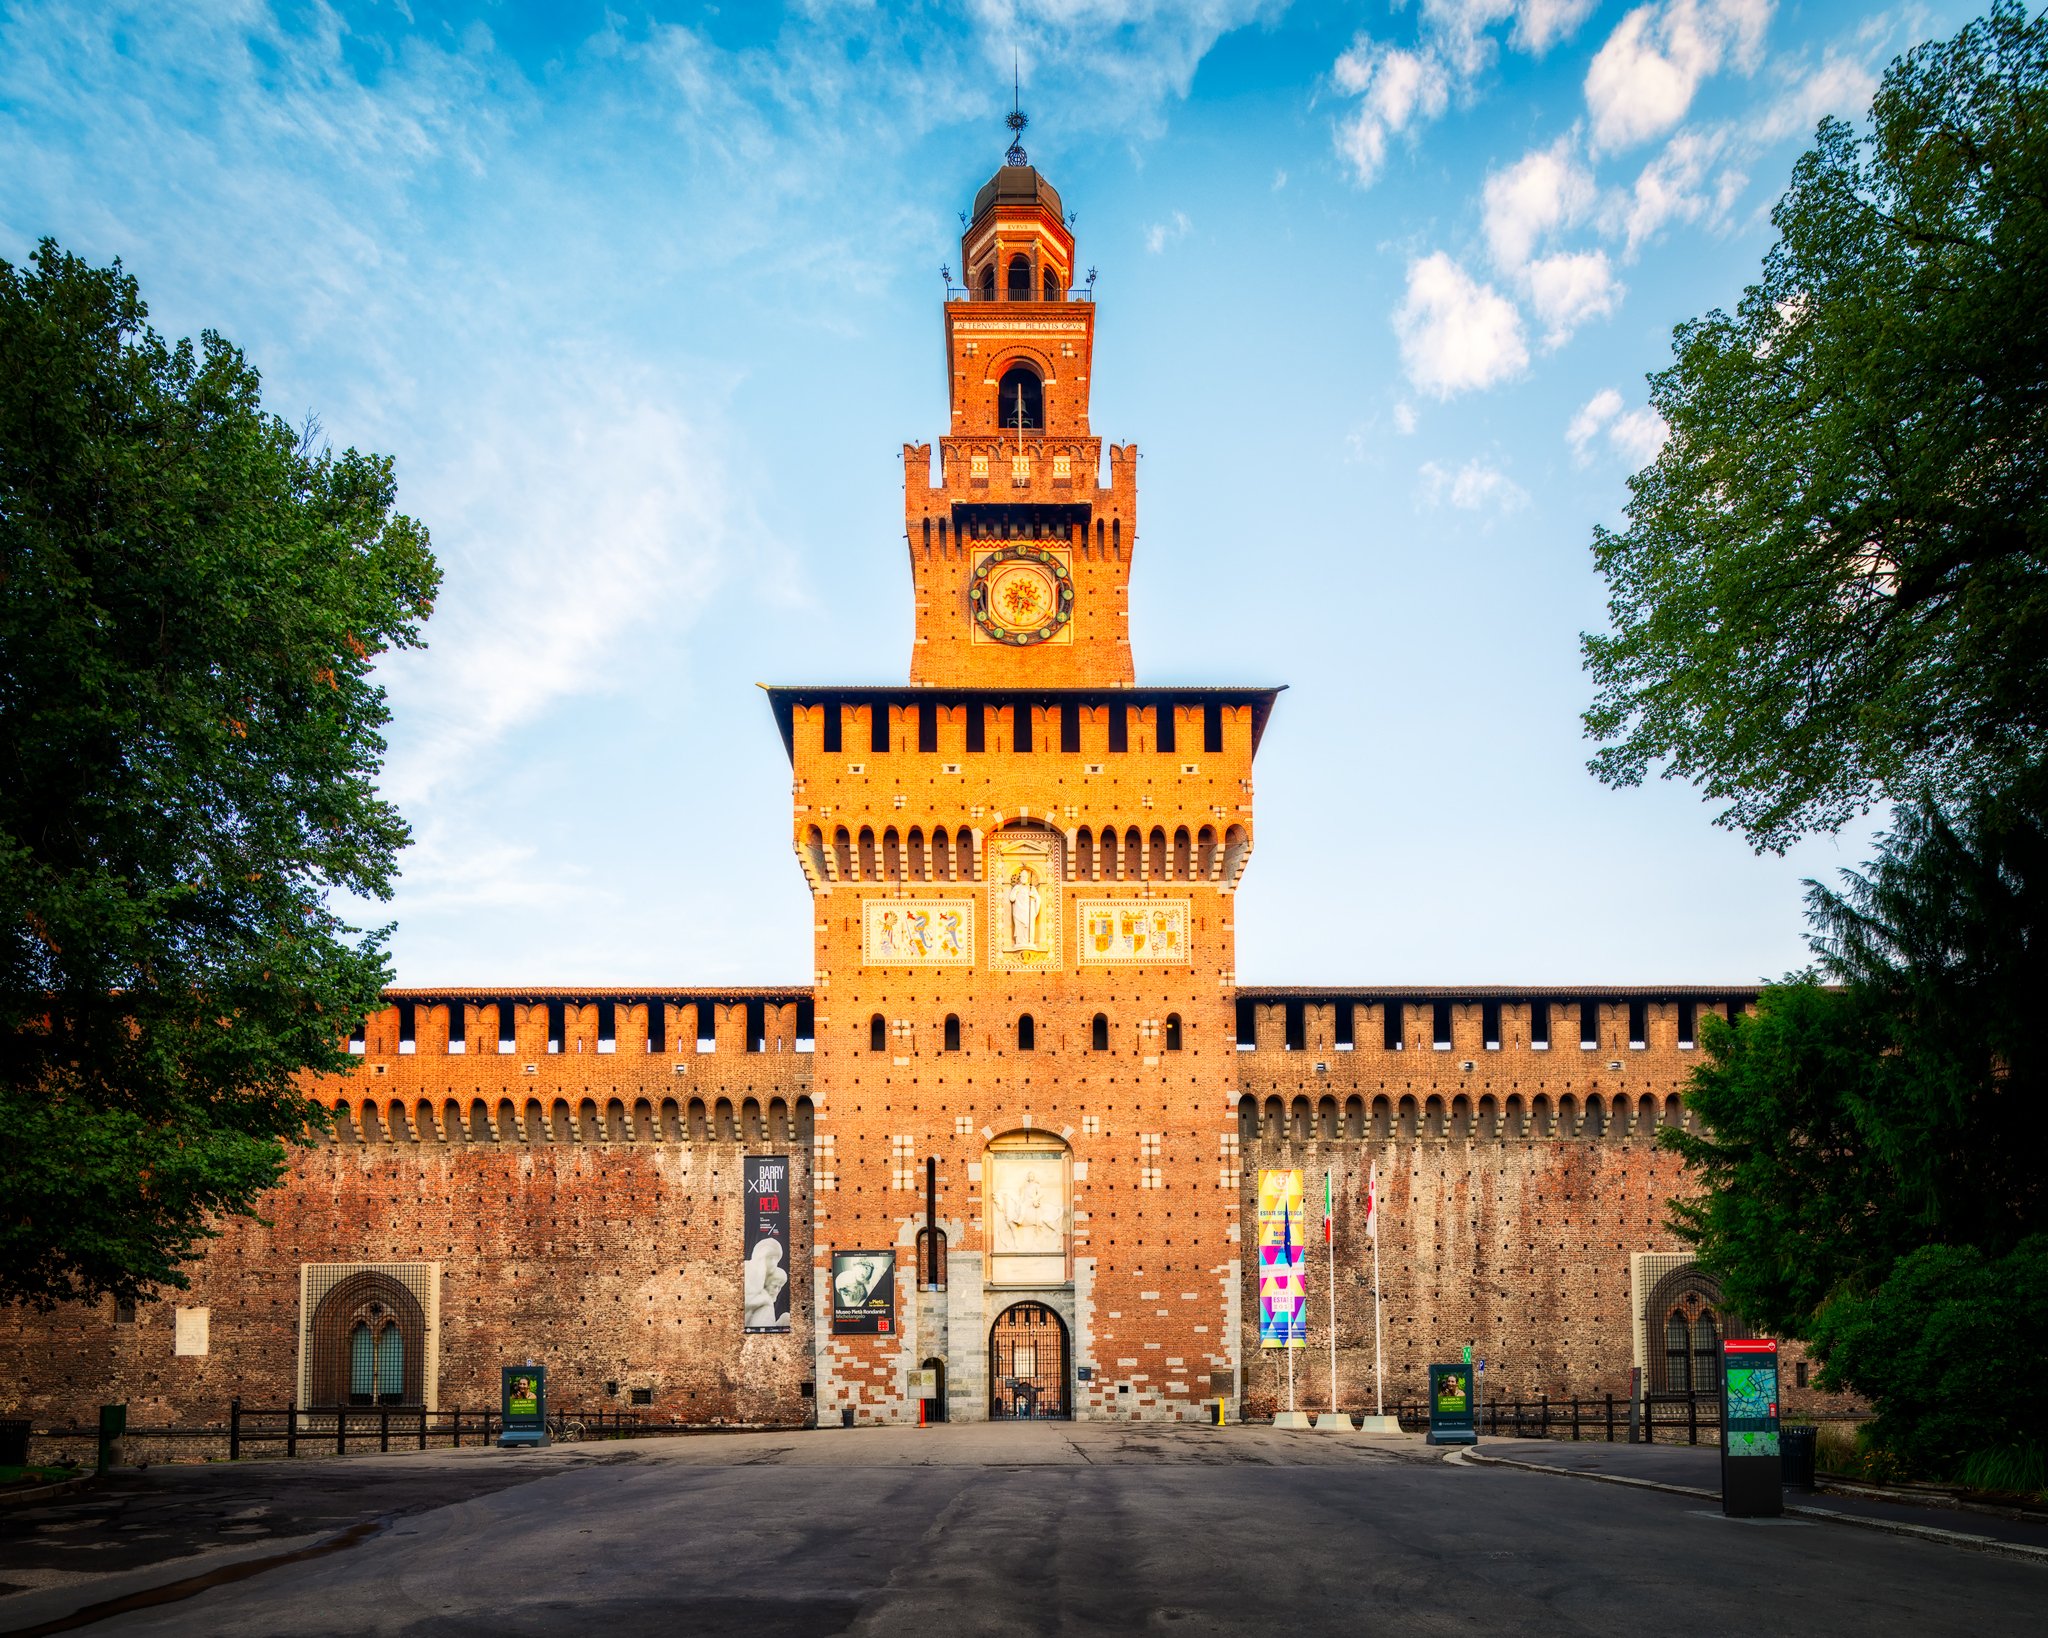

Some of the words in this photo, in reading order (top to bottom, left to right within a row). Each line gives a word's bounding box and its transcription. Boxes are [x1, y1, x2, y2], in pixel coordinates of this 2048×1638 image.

[1018, 546, 1027, 554] 12
[760, 1166, 784, 1179] BARRY
[760, 1180, 779, 1193] BALL
[760, 1194, 779, 1211] PIETÀ
